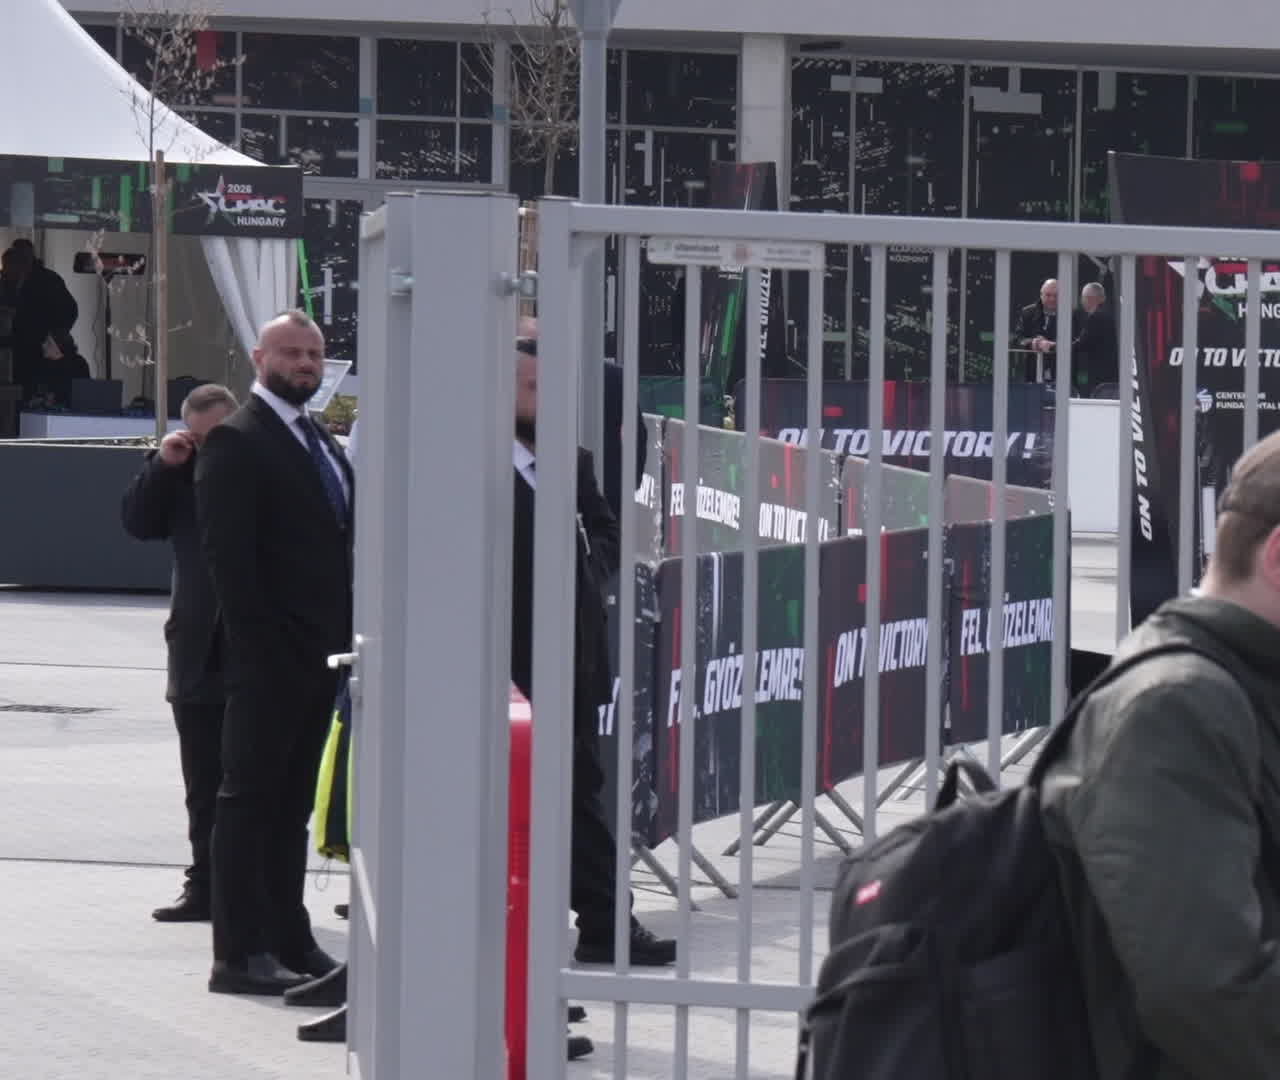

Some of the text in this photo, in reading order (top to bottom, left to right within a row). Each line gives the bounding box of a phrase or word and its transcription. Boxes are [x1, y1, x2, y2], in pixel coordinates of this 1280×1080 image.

[237, 216, 287, 227] HUNGARY
[1203, 348, 1228, 367] TO
[833, 428, 869, 455] TO
[759, 502, 772, 538] ON
[773, 504, 785, 541] TO
[833, 627, 860, 688] ON
